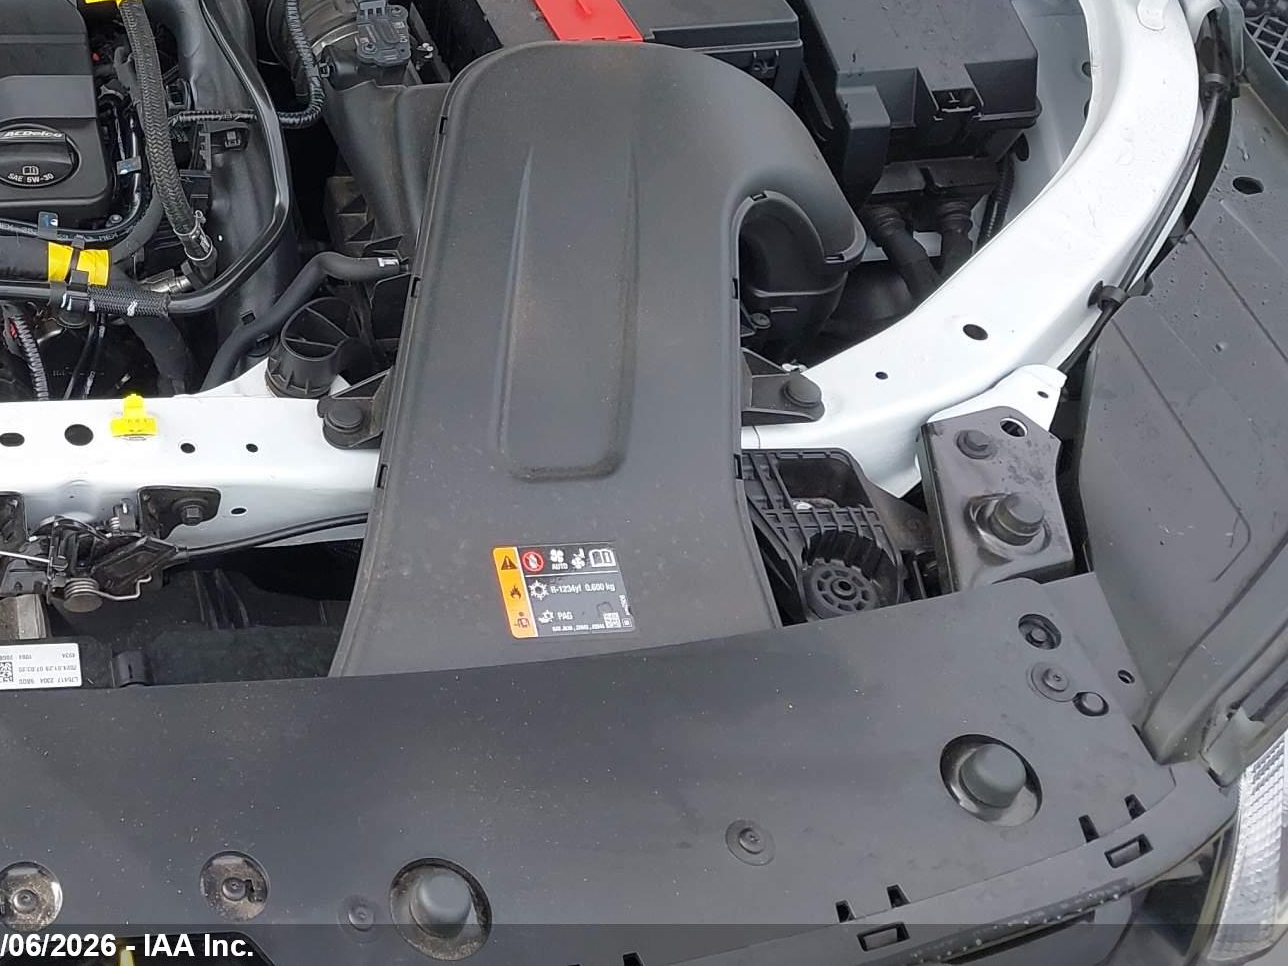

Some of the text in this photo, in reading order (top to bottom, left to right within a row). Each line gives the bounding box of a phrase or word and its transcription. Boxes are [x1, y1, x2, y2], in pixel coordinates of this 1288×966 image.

[4, 129, 64, 139] ACDelco
[7, 173, 55, 184] SAE 5W-30
[551, 562, 569, 571] AUTO
[605, 582, 616, 593] kg
[557, 611, 574, 621] PAG
